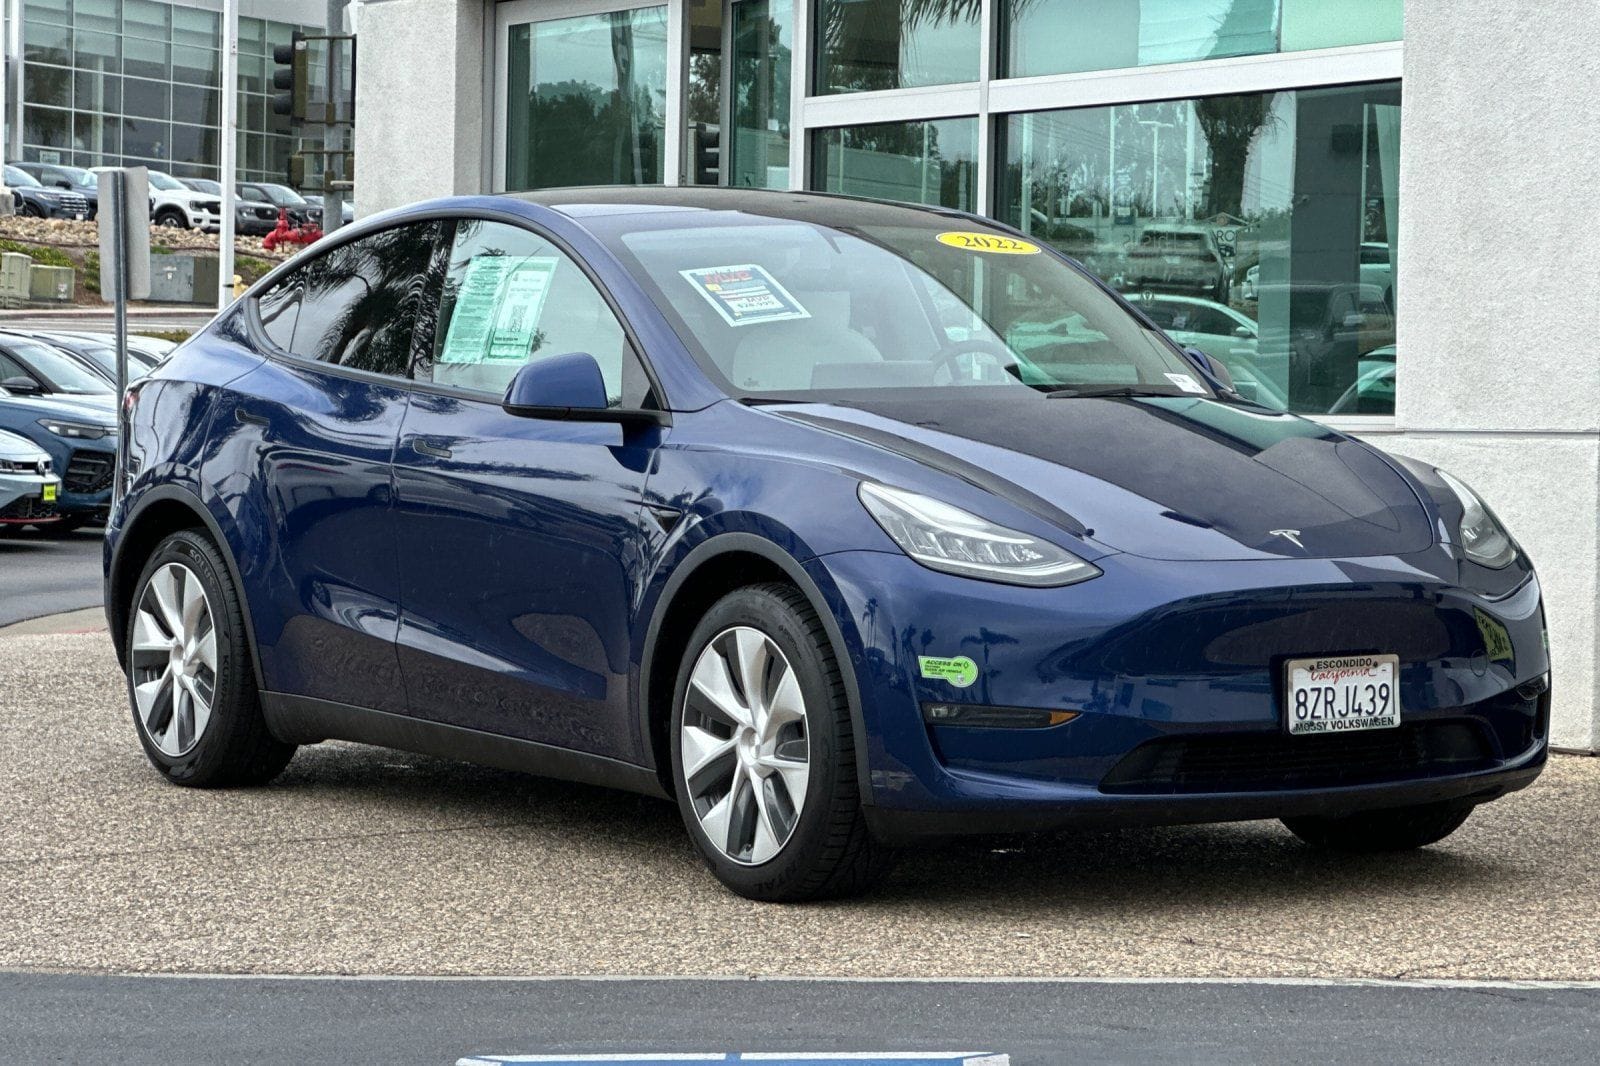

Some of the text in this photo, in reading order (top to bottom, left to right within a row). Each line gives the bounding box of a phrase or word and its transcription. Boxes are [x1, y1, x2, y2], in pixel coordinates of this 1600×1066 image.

[957, 235, 1023, 250] 2022
[190, 549, 215, 585] SOLUS
[1316, 658, 1372, 670] ESCONDIDO
[1310, 667, 1377, 684] California
[1295, 682, 1390, 720] 8ZRJ439
[1295, 717, 1394, 733] MOSSY VOLKSWAGEN
